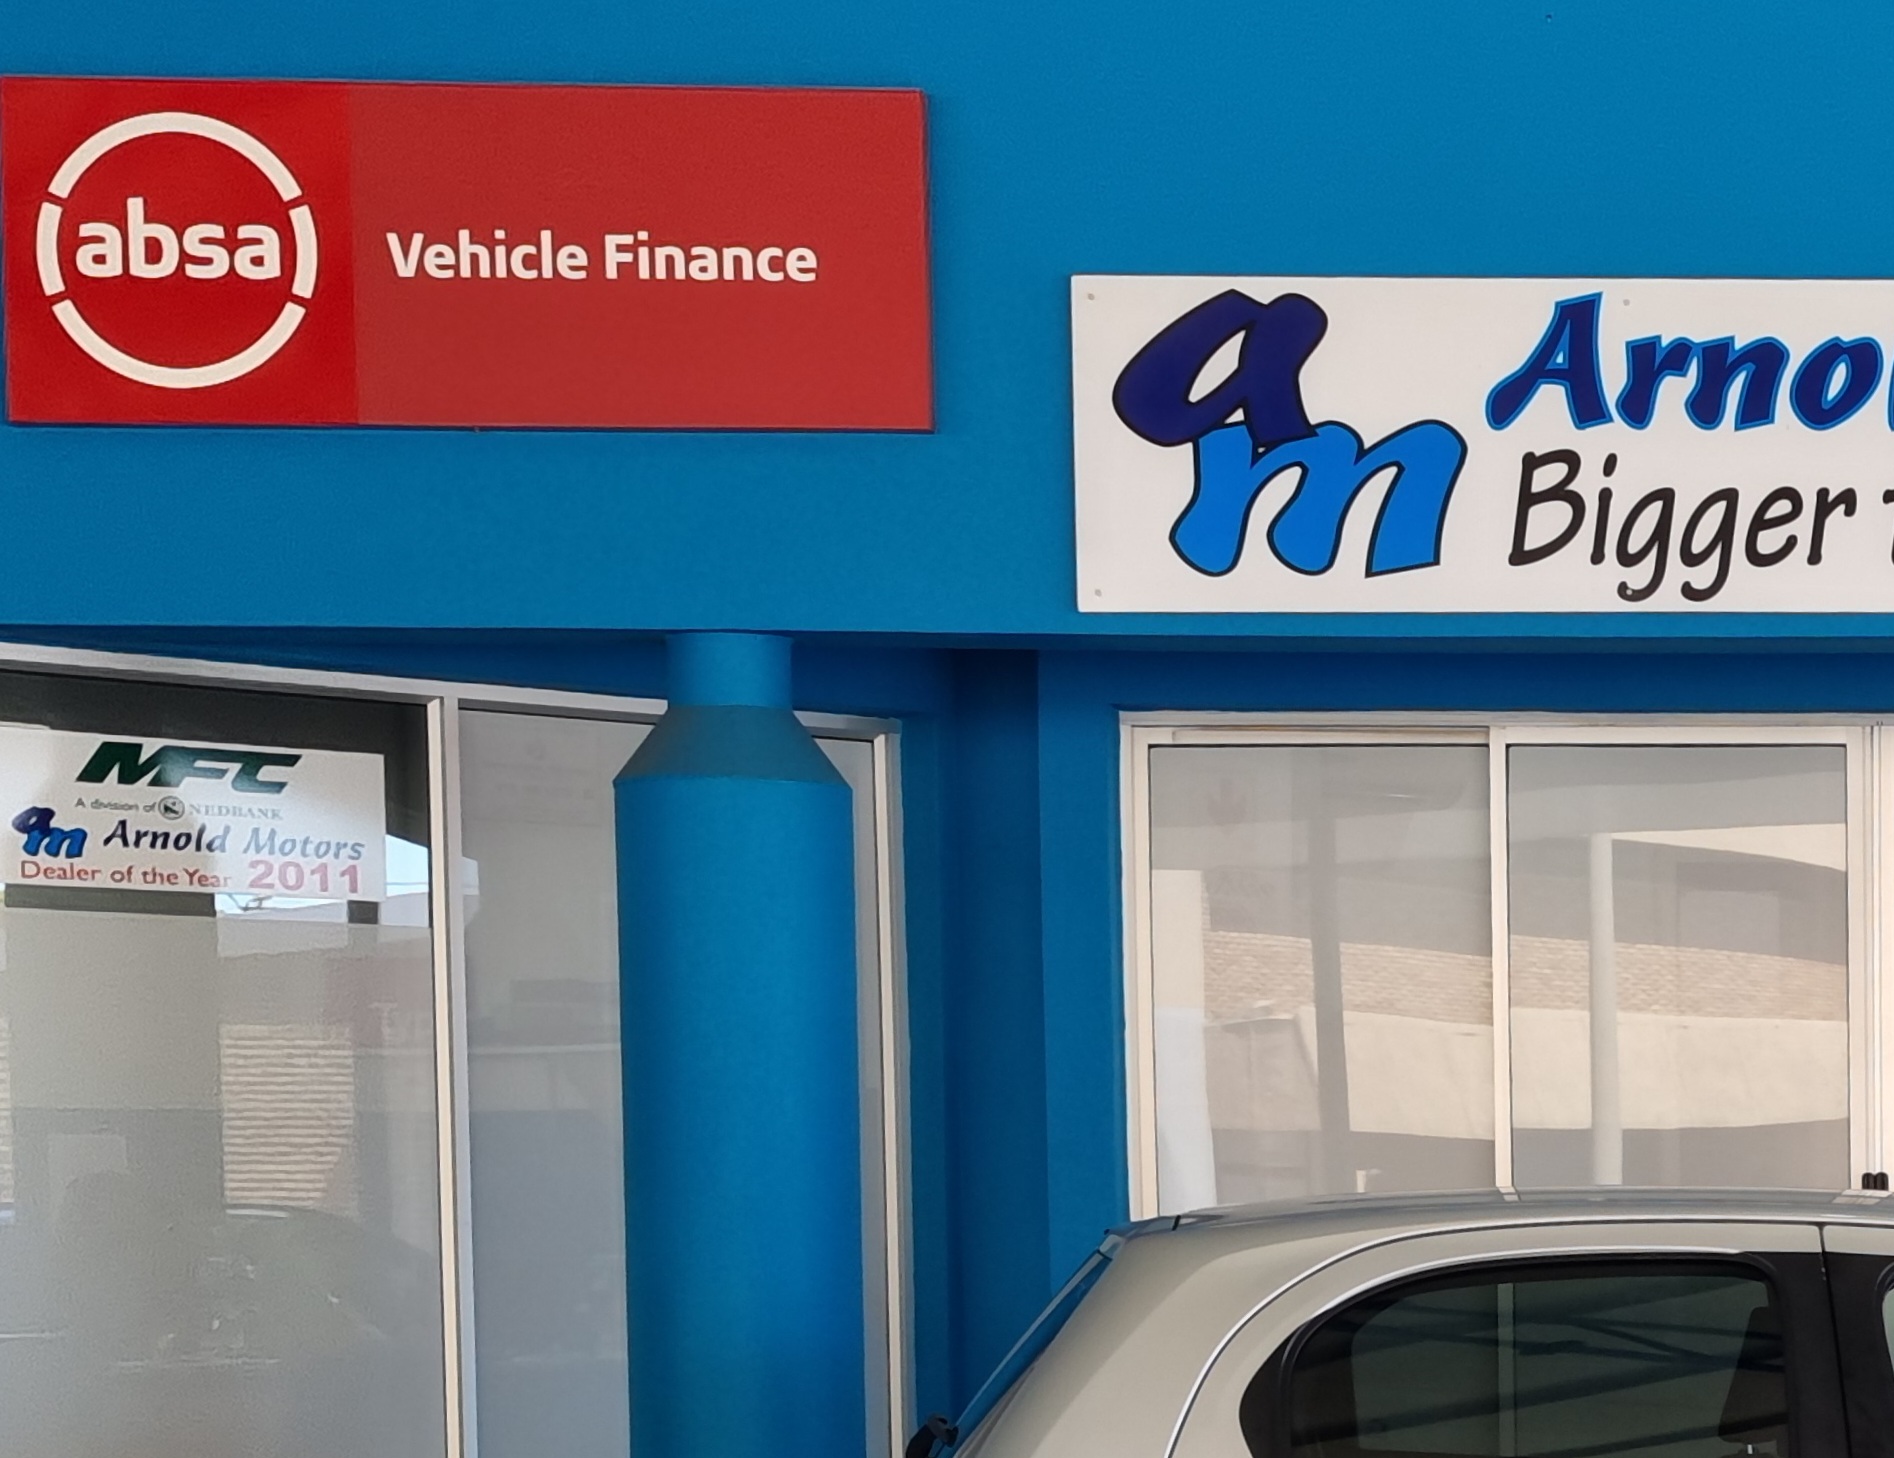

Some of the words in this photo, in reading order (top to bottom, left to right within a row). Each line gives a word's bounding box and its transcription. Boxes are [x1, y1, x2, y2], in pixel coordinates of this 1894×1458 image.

[75, 196, 282, 280] absa
[386, 231, 589, 281] Vehicle
[604, 232, 818, 283] Finance
[1508, 449, 1857, 602] Bigger
[75, 741, 302, 795] MFC
[75, 798, 86, 809] A
[90, 799, 139, 812] division
[142, 800, 157, 813] of
[189, 802, 283, 821] NEDBANK
[103, 819, 230, 854] Arnold
[242, 827, 365, 861] Motors
[21, 860, 101, 882] Dealer
[110, 865, 135, 884] of
[142, 867, 179, 886] the
[184, 868, 231, 888] Year
[248, 860, 360, 894] 2011
